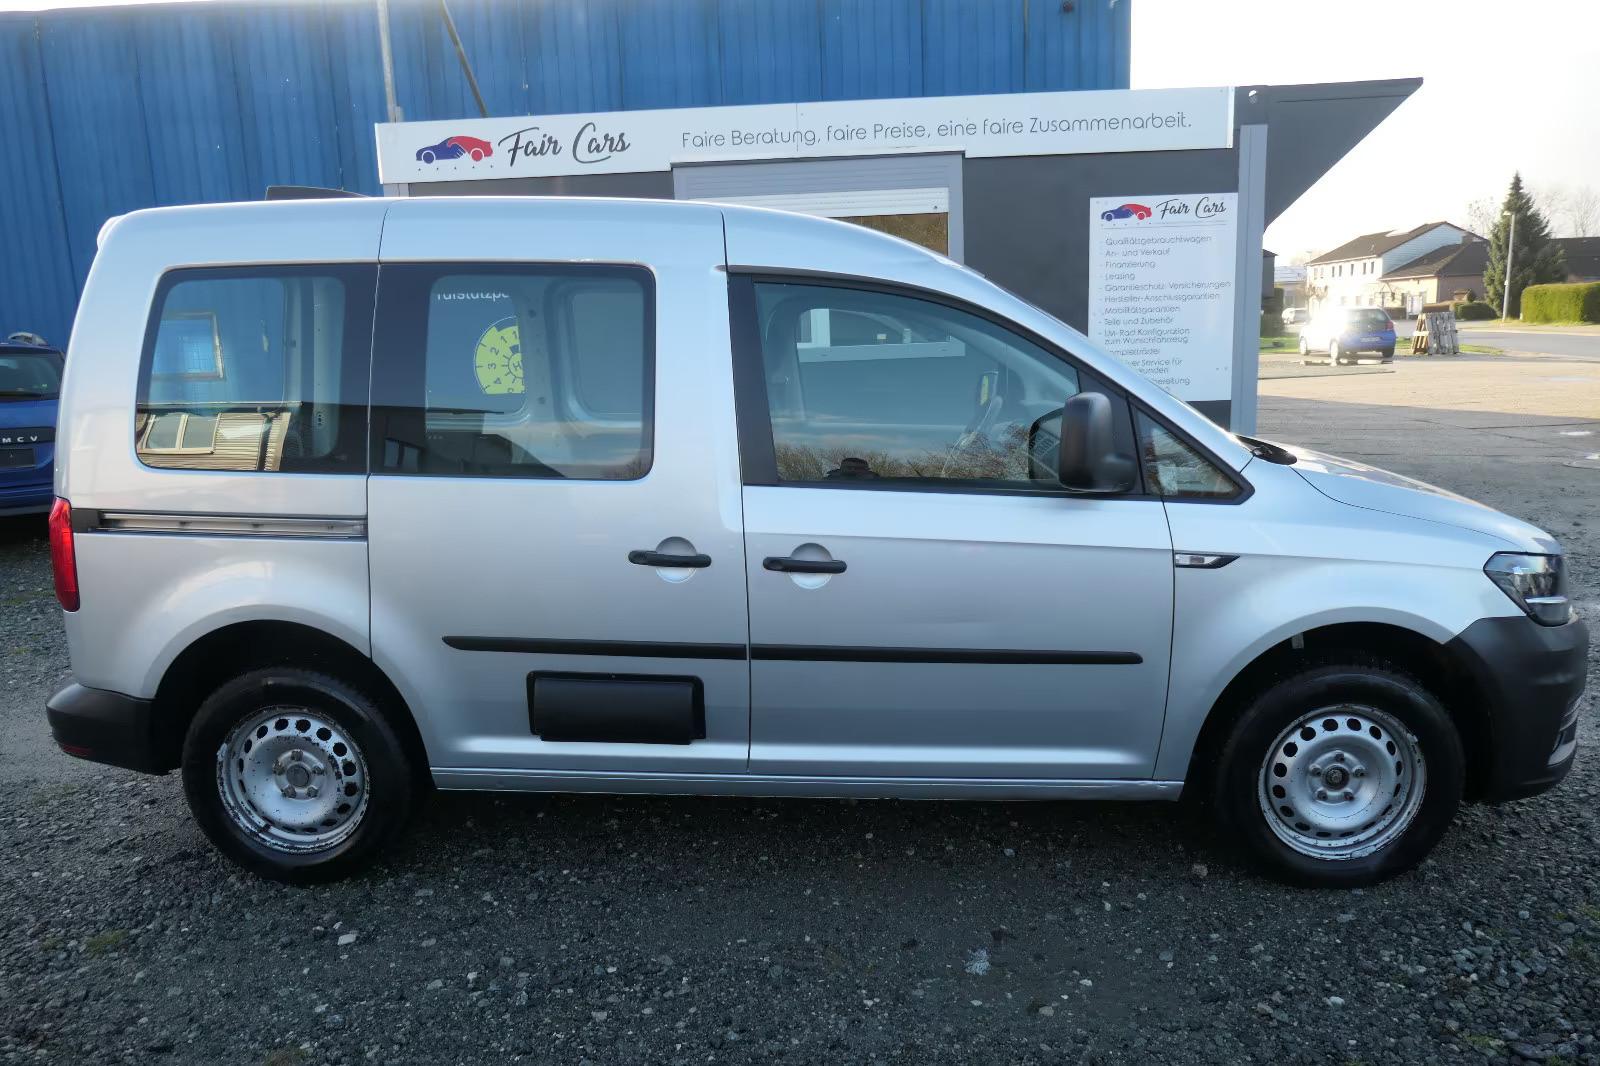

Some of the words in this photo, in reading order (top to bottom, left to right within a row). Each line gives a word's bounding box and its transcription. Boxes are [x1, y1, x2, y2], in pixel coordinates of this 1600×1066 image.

[681, 129, 726, 148] Faire
[730, 125, 821, 147] Beratung,
[826, 125, 867, 142] faire
[873, 122, 931, 139] Preise,
[937, 120, 978, 137] eine
[983, 117, 1024, 136] faire
[1028, 111, 1192, 134] Zusammenarbeit.
[498, 126, 562, 167] Fair
[572, 121, 631, 164] Cars
[1155, 198, 1190, 220] Fair
[1195, 196, 1227, 219] Cars
[1121, 249, 1138, 257] und
[1140, 248, 1171, 256] Verkauf
[1105, 261, 1156, 269] Finanzierung
[1105, 272, 1136, 281] Leasing
[1169, 281, 1232, 290] Versicherungen
[1104, 318, 1121, 326] Teile
[1122, 317, 1139, 325] und
[1140, 316, 1174, 325] Zubehör
[1137, 327, 1191, 336] Konfiguration
[1104, 338, 1121, 346] zum
[1141, 358, 1170, 367] Service
[1171, 357, 1183, 366] für
